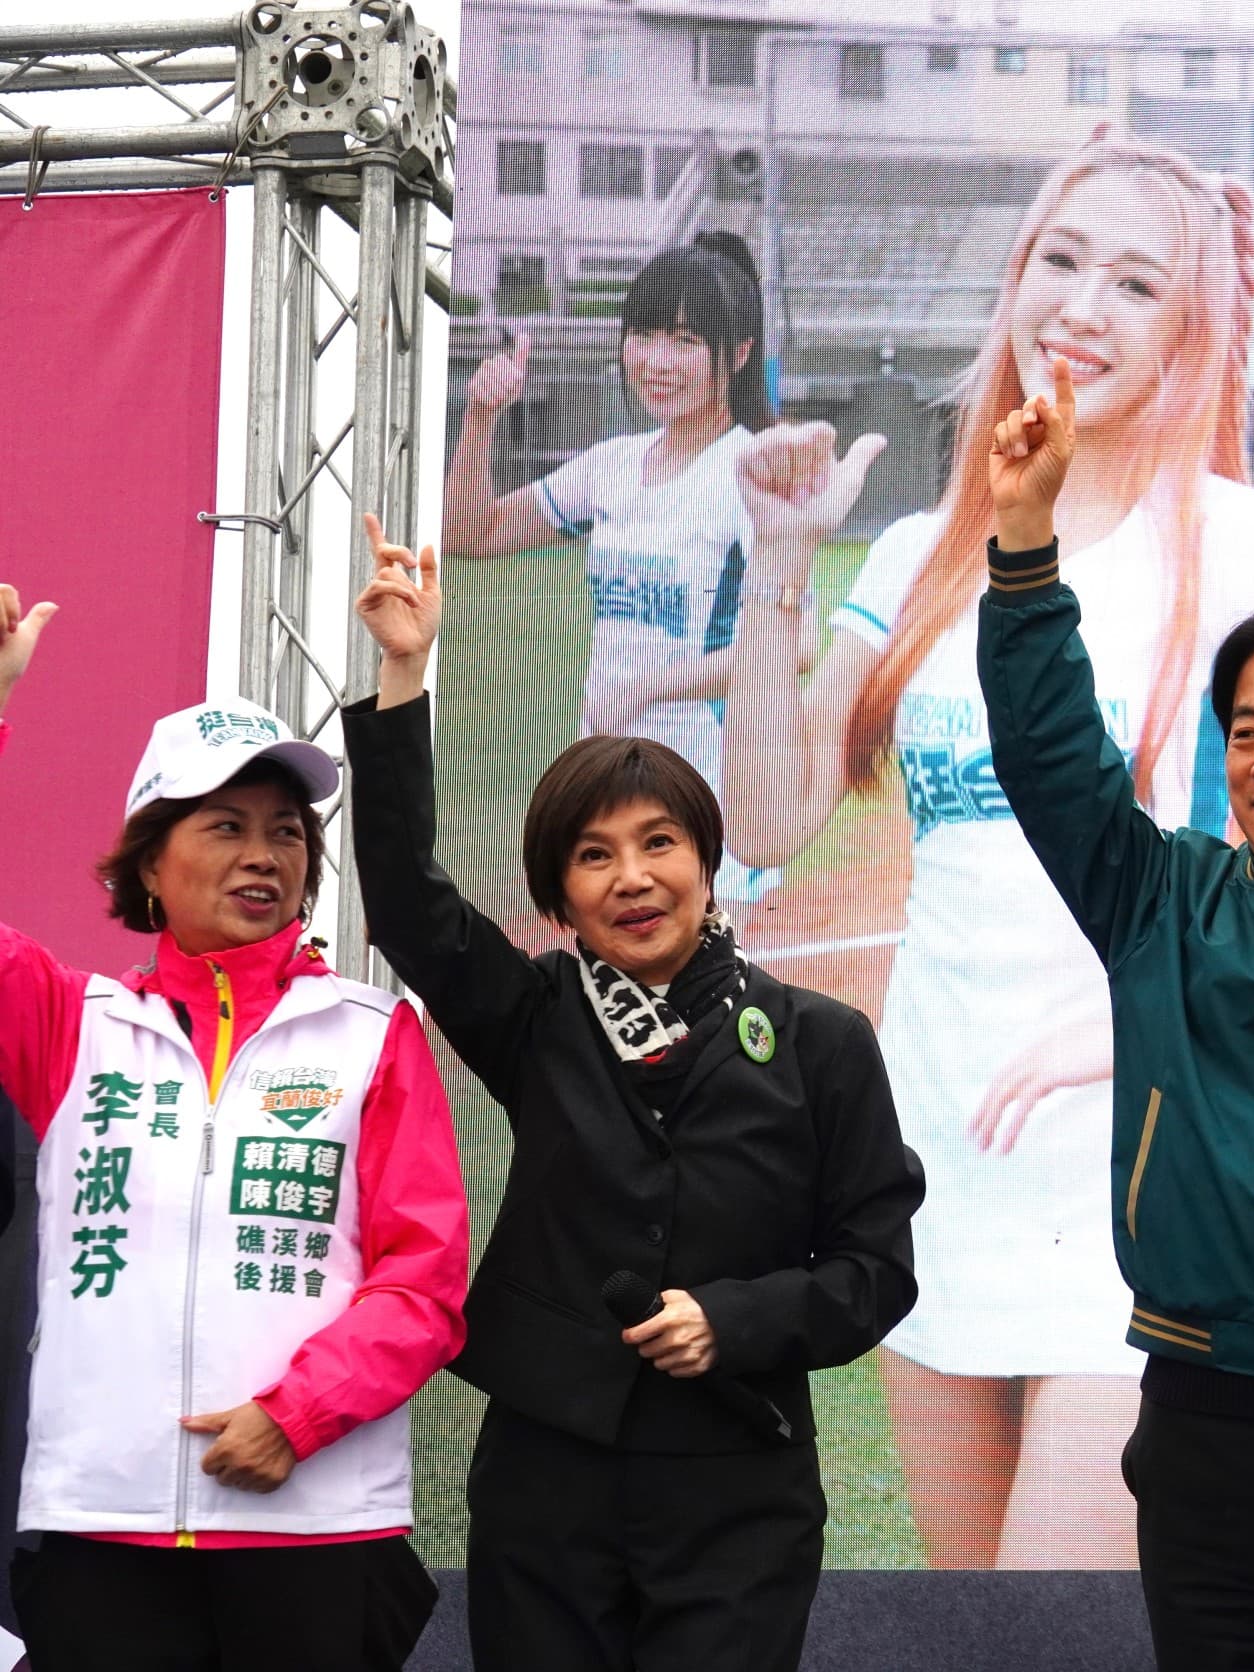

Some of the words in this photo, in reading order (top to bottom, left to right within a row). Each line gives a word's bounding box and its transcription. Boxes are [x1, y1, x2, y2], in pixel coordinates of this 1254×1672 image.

[148, 1079, 184, 1139] 會長
[242, 1141, 340, 1177] 賴清德
[70, 1071, 144, 1300] 李淑芬
[240, 1178, 334, 1216] 陳俊宇
[236, 1225, 332, 1262] 礁溪鄉
[234, 1261, 327, 1298] 後援會
